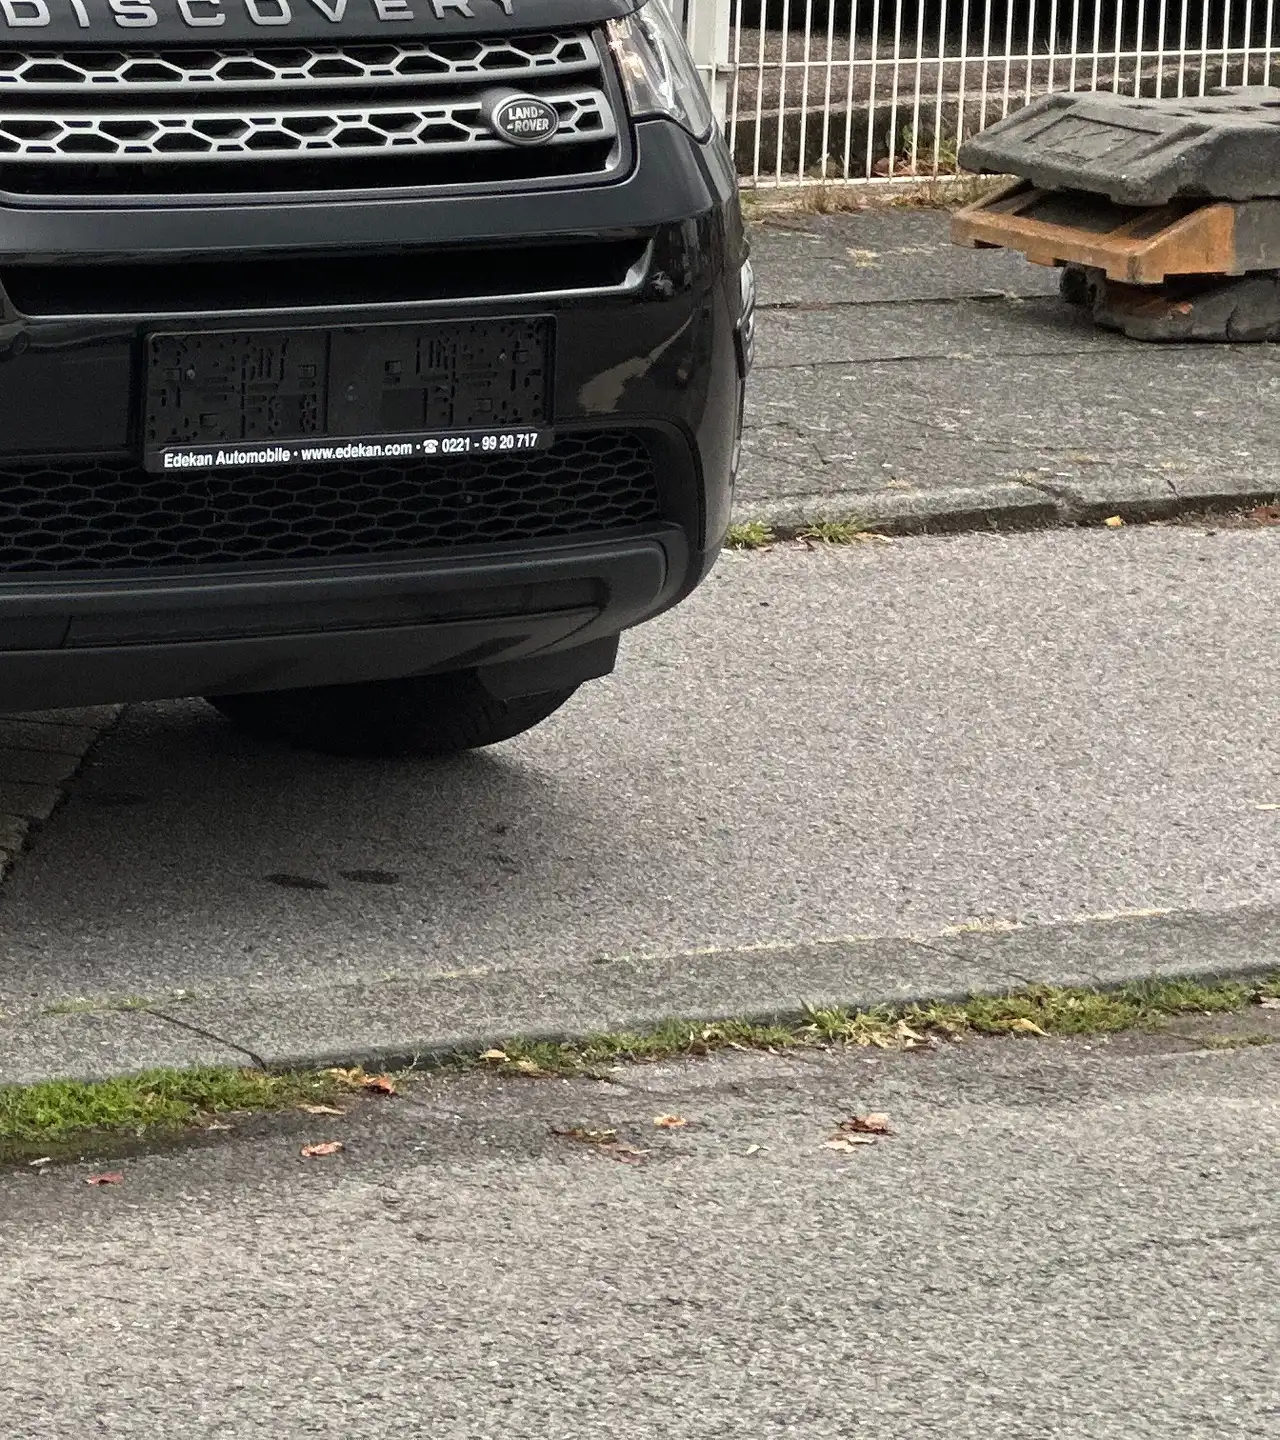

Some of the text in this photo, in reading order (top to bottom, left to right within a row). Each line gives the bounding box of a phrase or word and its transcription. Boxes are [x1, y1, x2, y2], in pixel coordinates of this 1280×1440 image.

[508, 106, 538, 121] LAND
[514, 118, 549, 133] ROVER
[163, 451, 213, 468] Edekan
[215, 447, 291, 466] Automobile
[301, 442, 413, 461] www.edekan.com
[441, 437, 471, 453] 0221
[481, 435, 497, 451] 99
[499, 434, 514, 450] 20
[516, 433, 538, 448] 717
